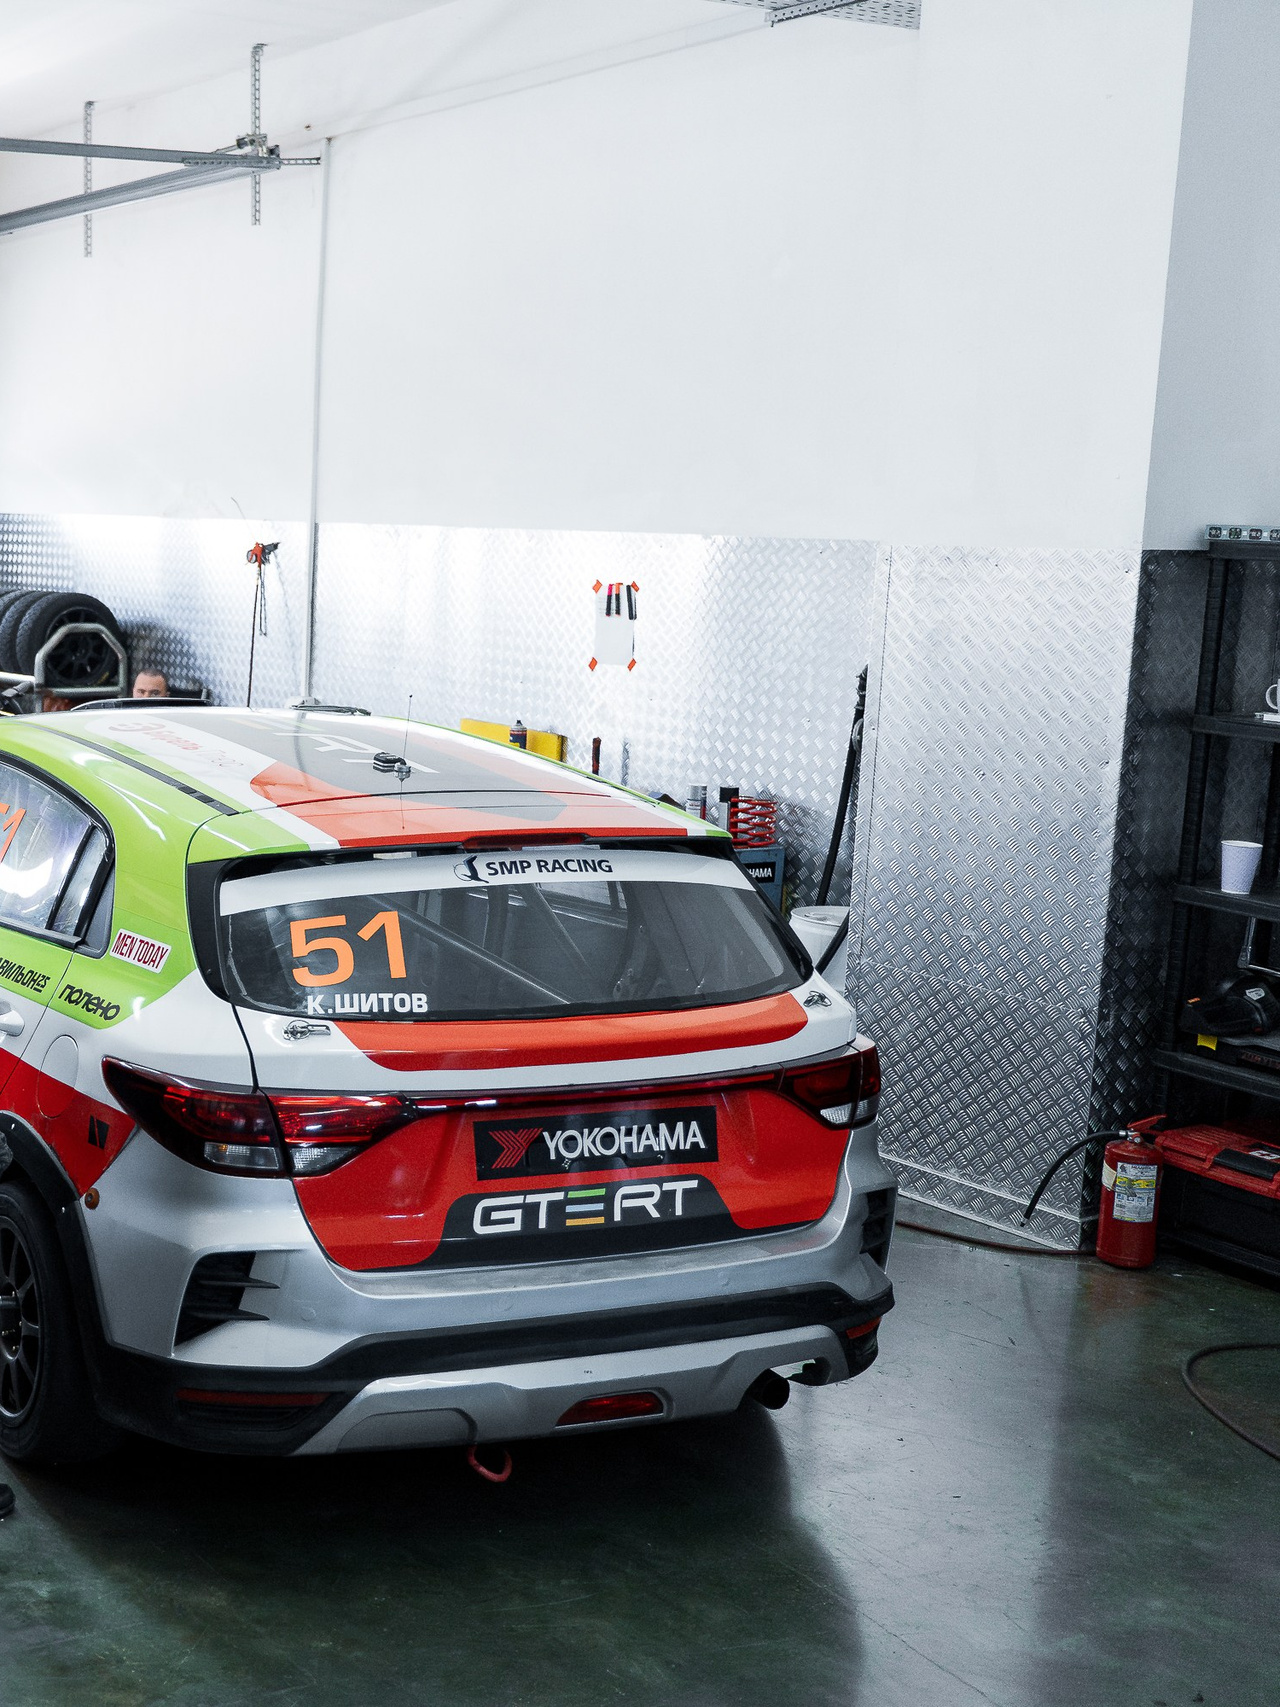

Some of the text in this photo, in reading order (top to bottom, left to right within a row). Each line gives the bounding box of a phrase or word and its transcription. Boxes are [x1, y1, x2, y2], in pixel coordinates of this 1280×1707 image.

[485, 859, 614, 876] SMP RACING
[111, 931, 169, 970] MEN TODAY
[289, 910, 407, 988] 51
[306, 992, 429, 1015] К.ШИТОВ
[542, 1120, 706, 1160] YOKOHAMA
